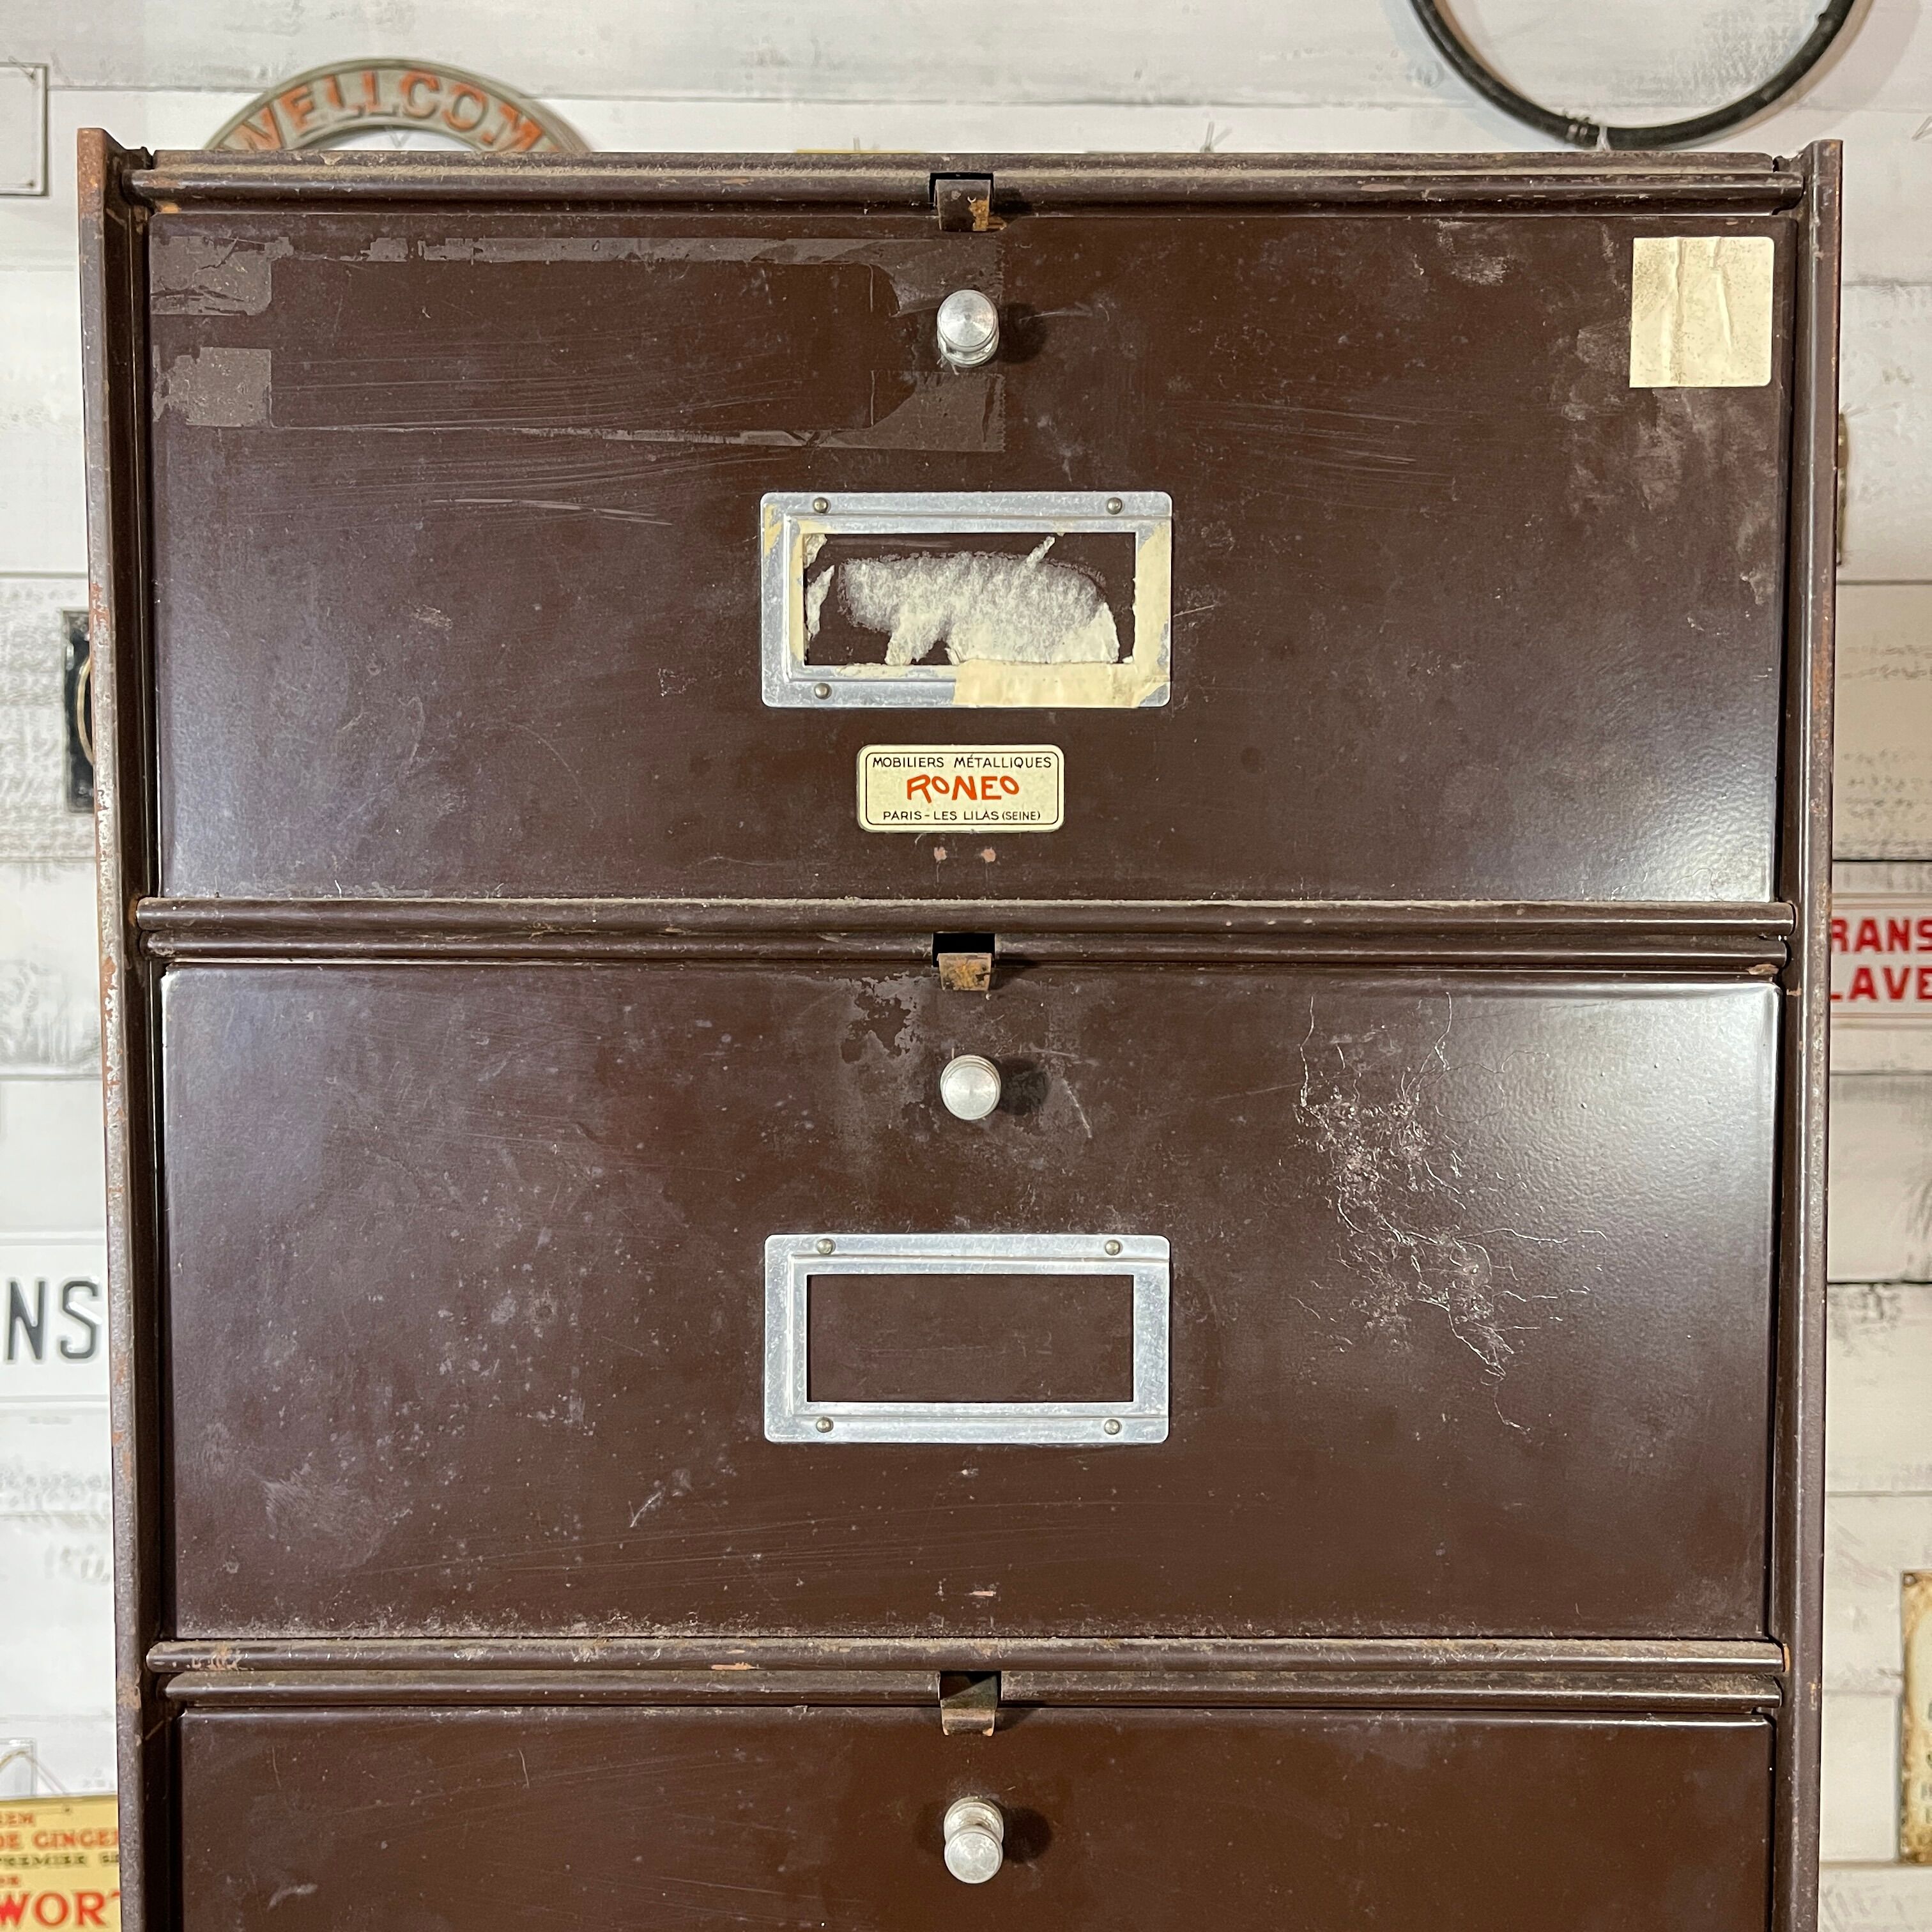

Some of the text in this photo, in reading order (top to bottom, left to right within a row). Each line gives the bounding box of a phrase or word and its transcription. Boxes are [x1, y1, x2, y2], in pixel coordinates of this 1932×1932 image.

[224, 69, 560, 151] WELLCOM
[872, 755, 1052, 769] MOBILIERS MÉTALLIQUES
[906, 774, 1020, 804] RONEO
[883, 810, 922, 821] PARIS
[963, 809, 999, 821] LILAS
[1002, 811, 1041, 822] (SEINE)
[7, 1279, 100, 1362] NS
[34, 1830, 119, 1848] GINGE
